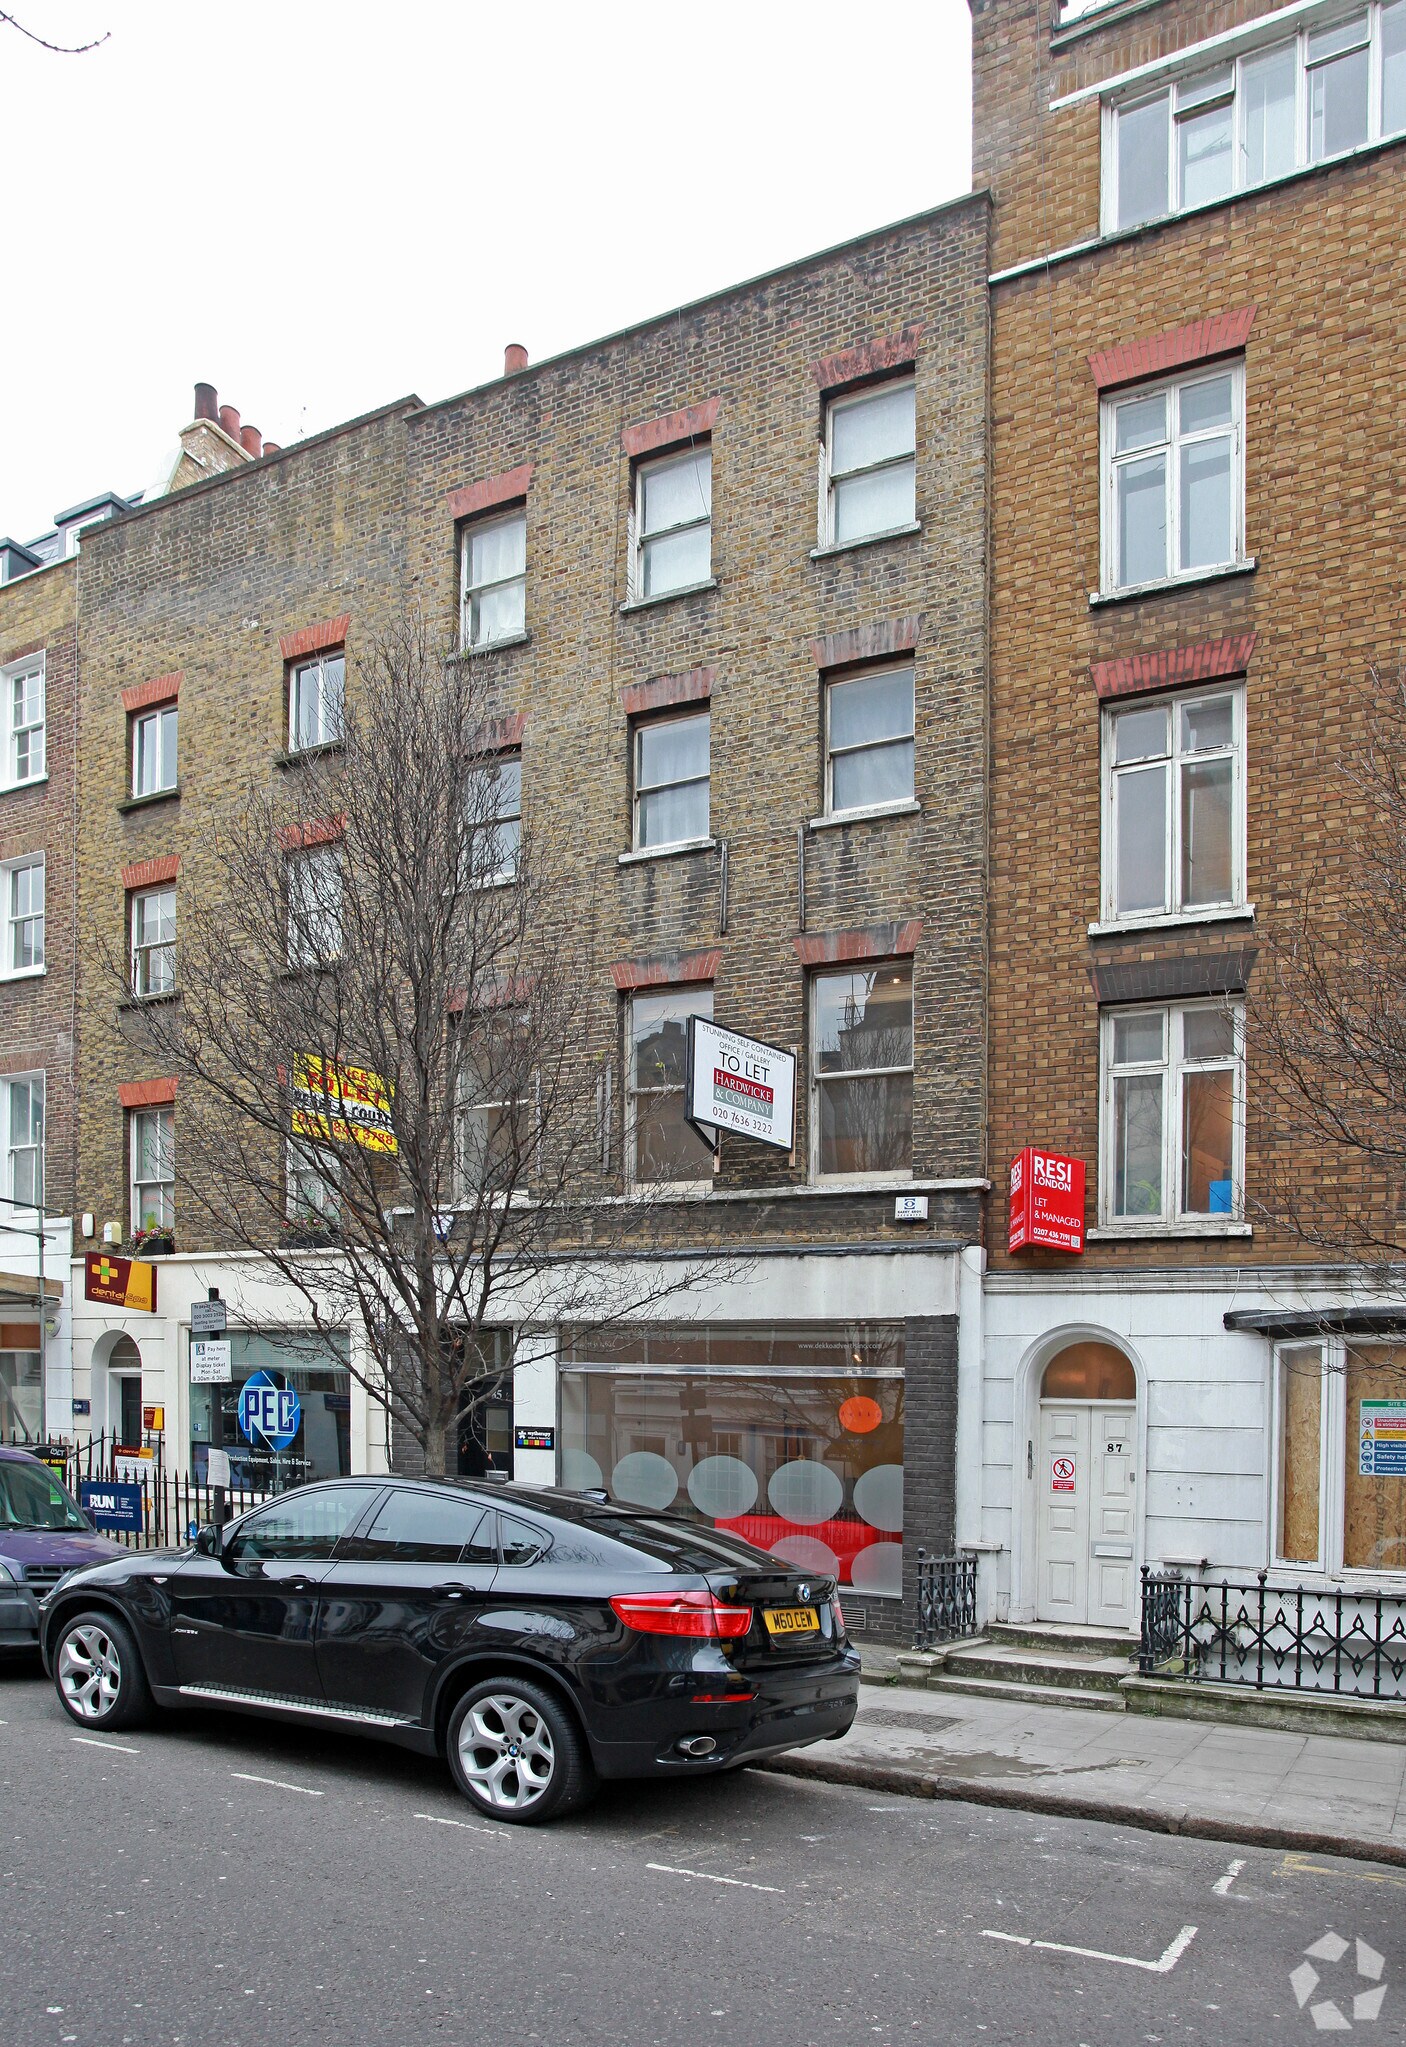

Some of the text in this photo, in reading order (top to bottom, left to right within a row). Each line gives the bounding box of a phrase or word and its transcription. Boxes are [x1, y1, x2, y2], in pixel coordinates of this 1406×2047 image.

[702, 1024, 786, 1062] STUNNING SELF CONTAINED
[719, 1041, 740, 1055] OFFICE
[745, 1051, 770, 1065] GALLERY
[719, 1051, 770, 1082] TO LET
[343, 1082, 384, 1106] LET
[715, 1071, 771, 1102] HARDWICKE
[716, 1088, 724, 1100] &
[725, 1090, 770, 1114] COMPANY
[712, 1106, 728, 1120] 020
[731, 1112, 750, 1126] 7636
[752, 1120, 772, 1134] 3222
[1034, 1155, 1072, 1183] RESI
[1034, 1175, 1071, 1192] LONDON
[1034, 1196, 1048, 1208] LET
[1034, 1210, 1080, 1228] & MANAGED
[1034, 1227, 1048, 1236] 0207
[91, 1287, 124, 1300] dental
[244, 1390, 294, 1433] PEC
[1107, 1444, 1122, 1452] 87
[90, 1494, 115, 1509] RUN
